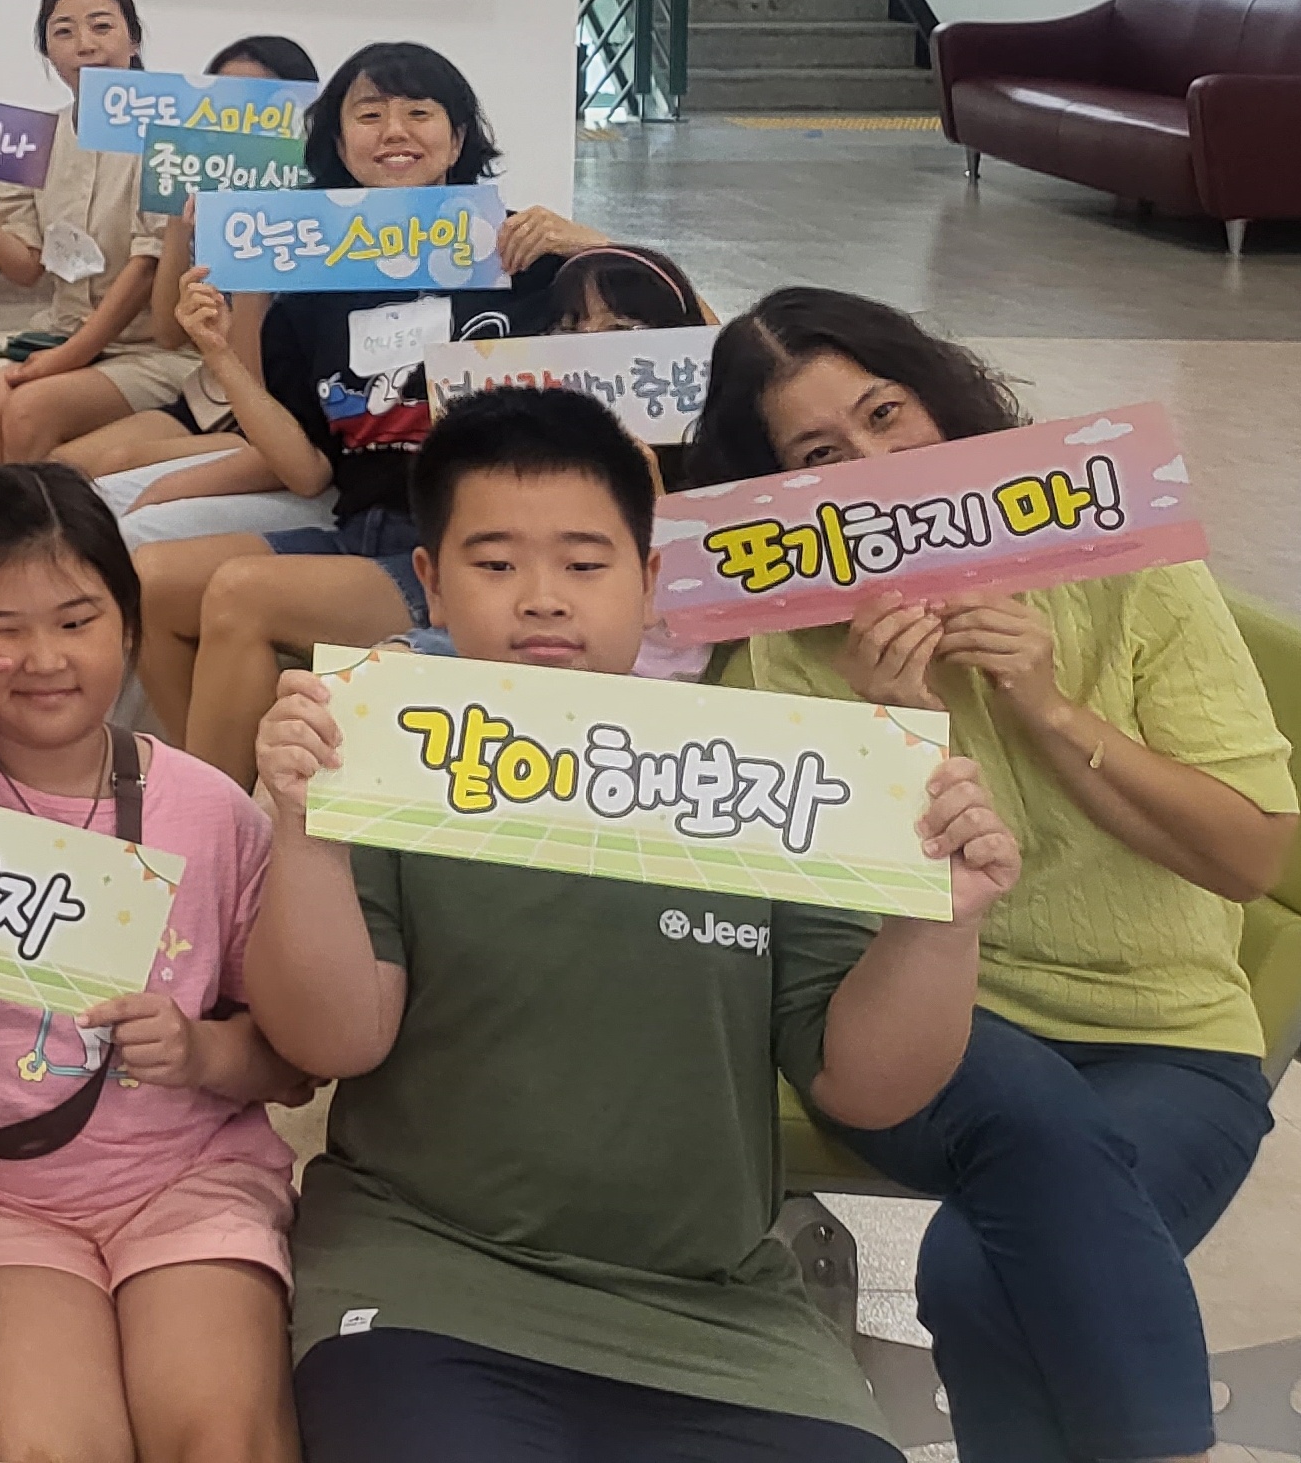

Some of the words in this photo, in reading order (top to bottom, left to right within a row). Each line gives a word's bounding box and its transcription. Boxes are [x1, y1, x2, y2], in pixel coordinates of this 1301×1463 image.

[103, 85, 181, 138] 오늘도
[184, 96, 295, 139] 스마일
[148, 141, 203, 197] 좋은
[204, 153, 257, 192] 일이
[224, 210, 331, 272] 오늘도
[323, 209, 474, 268] 스마일
[629, 356, 712, 419] 충분
[705, 490, 991, 594] 포기하지
[991, 454, 1126, 537] 마!
[398, 703, 579, 814] 같이
[585, 722, 851, 855] 해보자
[692, 911, 771, 957] Jeep
